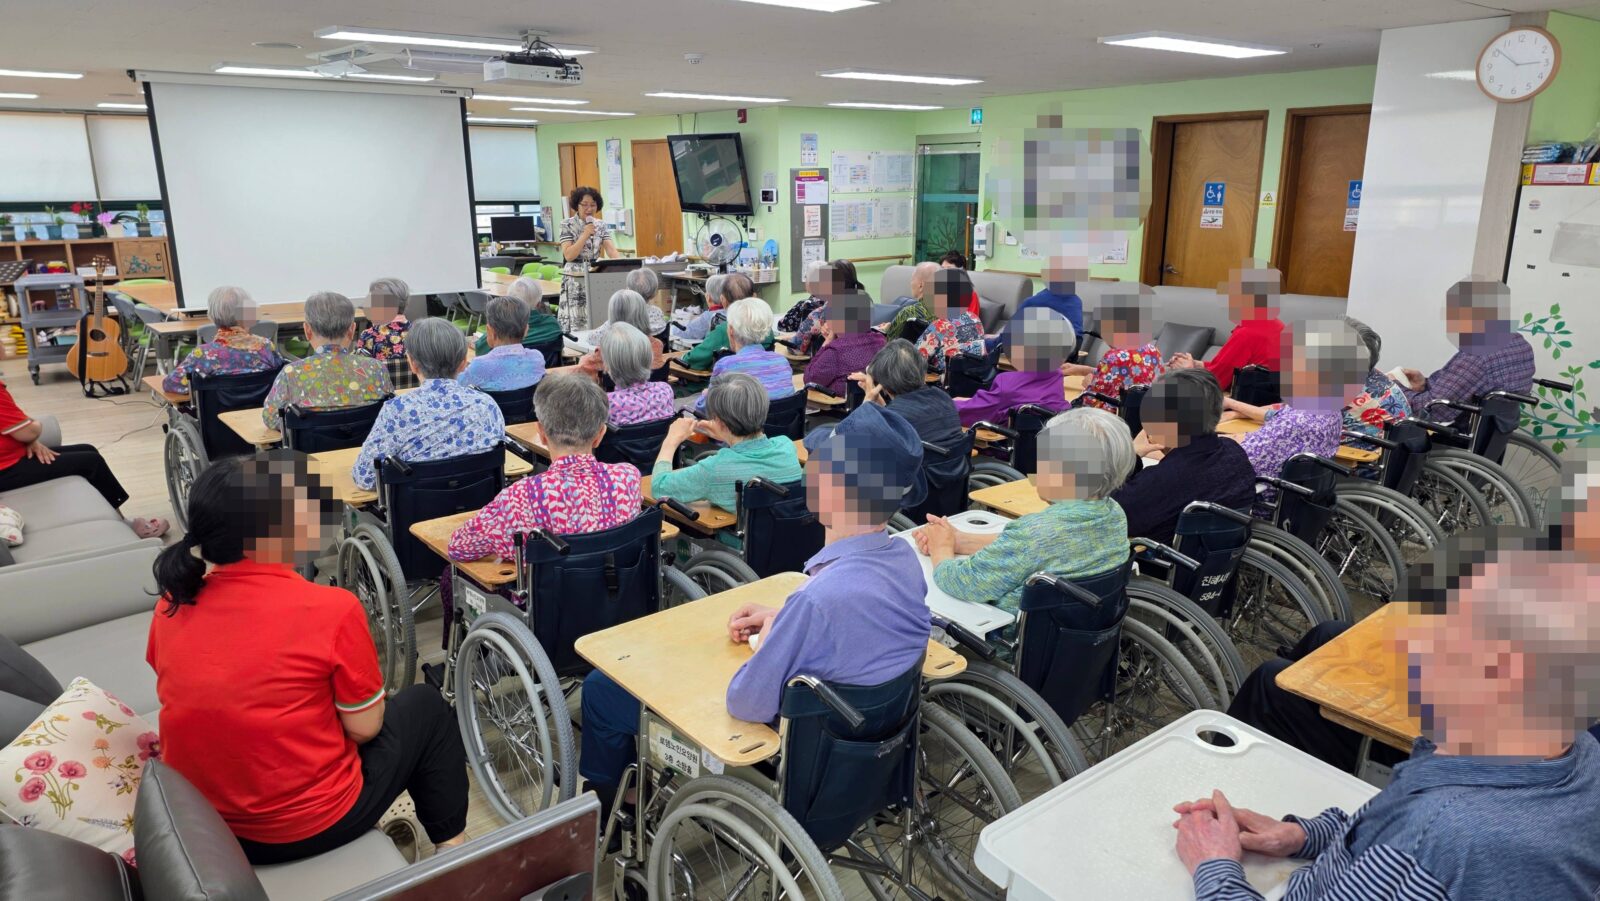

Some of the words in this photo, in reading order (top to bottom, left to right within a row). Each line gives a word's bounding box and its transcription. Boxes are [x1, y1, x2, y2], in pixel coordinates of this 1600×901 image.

[1518, 34, 1526, 42] 12
[1503, 39, 1511, 48] 11
[1492, 49, 1500, 58] 10
[1542, 45, 1548, 54] 2
[1544, 58, 1549, 67] 3
[1487, 63, 1493, 71] 9
[1489, 75, 1494, 83] 8
[1526, 82, 1532, 90] 5
[1511, 87, 1516, 95] 6
